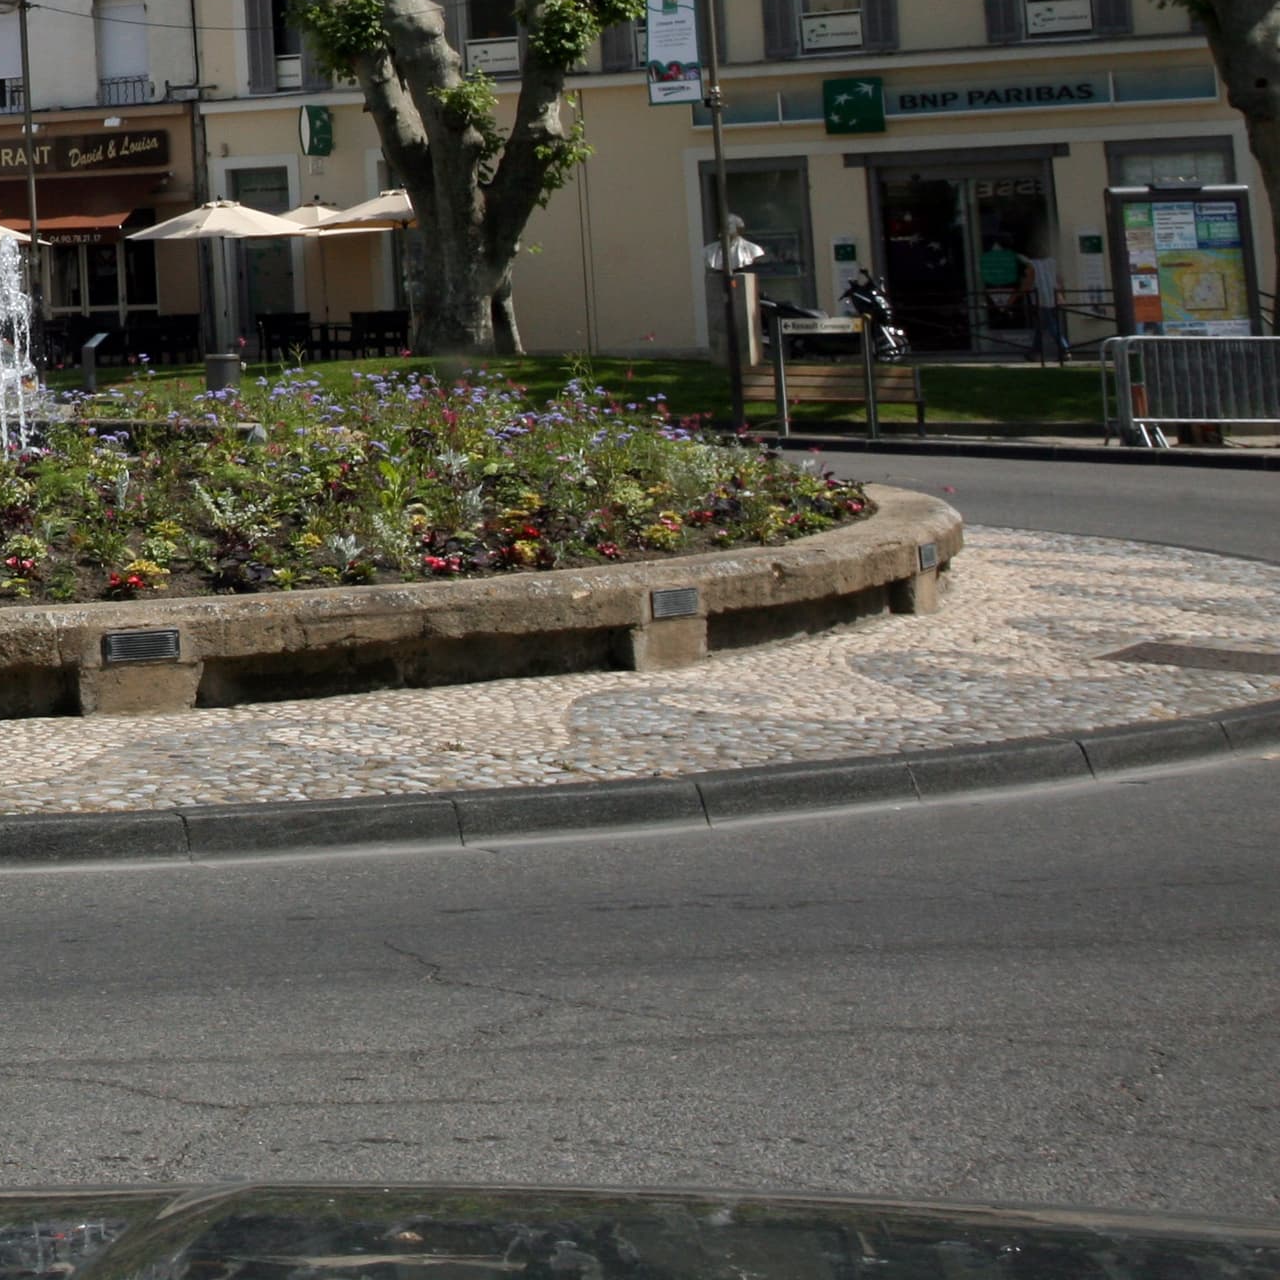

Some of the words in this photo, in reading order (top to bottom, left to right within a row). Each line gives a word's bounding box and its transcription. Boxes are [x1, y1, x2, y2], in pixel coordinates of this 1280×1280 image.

[899, 92, 958, 110] BNP
[967, 83, 1094, 106] PARIBAS
[69, 145, 104, 168] David
[107, 138, 116, 155] &
[119, 135, 159, 156] Louisa
